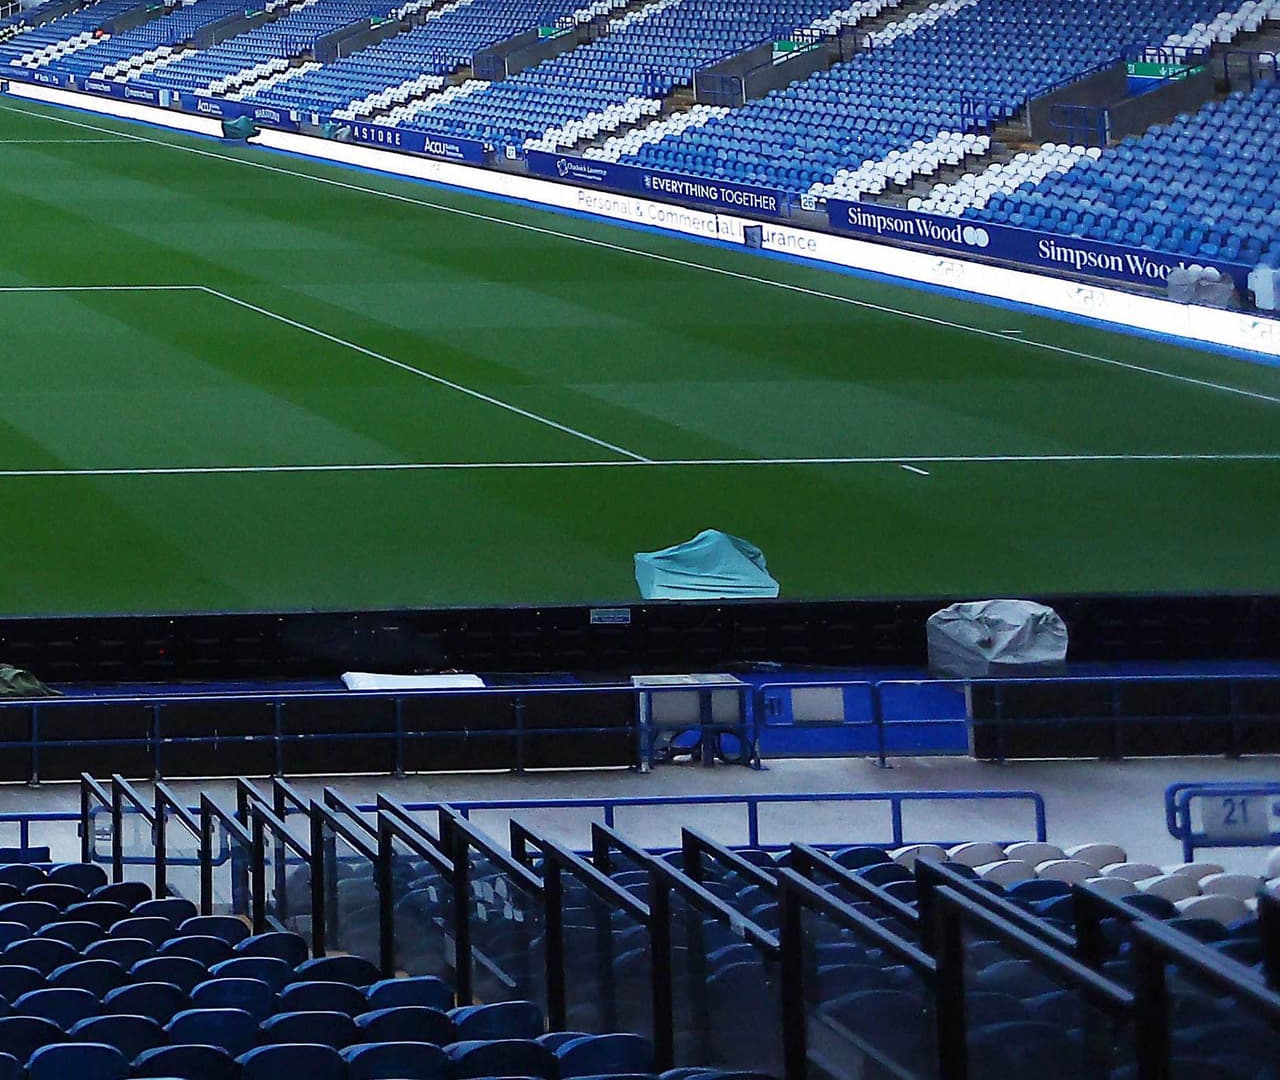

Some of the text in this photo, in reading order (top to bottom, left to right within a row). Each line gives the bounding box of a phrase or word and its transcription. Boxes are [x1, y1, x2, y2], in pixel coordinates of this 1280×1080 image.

[345, 124, 401, 146] ASTORE
[652, 176, 777, 211] EVERYTHING TOGETHER
[802, 197, 815, 208] 26
[576, 189, 818, 253] Personal & Commercal Iurance
[847, 206, 963, 245] Simpson Wood
[1037, 238, 1122, 273] Simpson
[1222, 797, 1248, 825] 21
